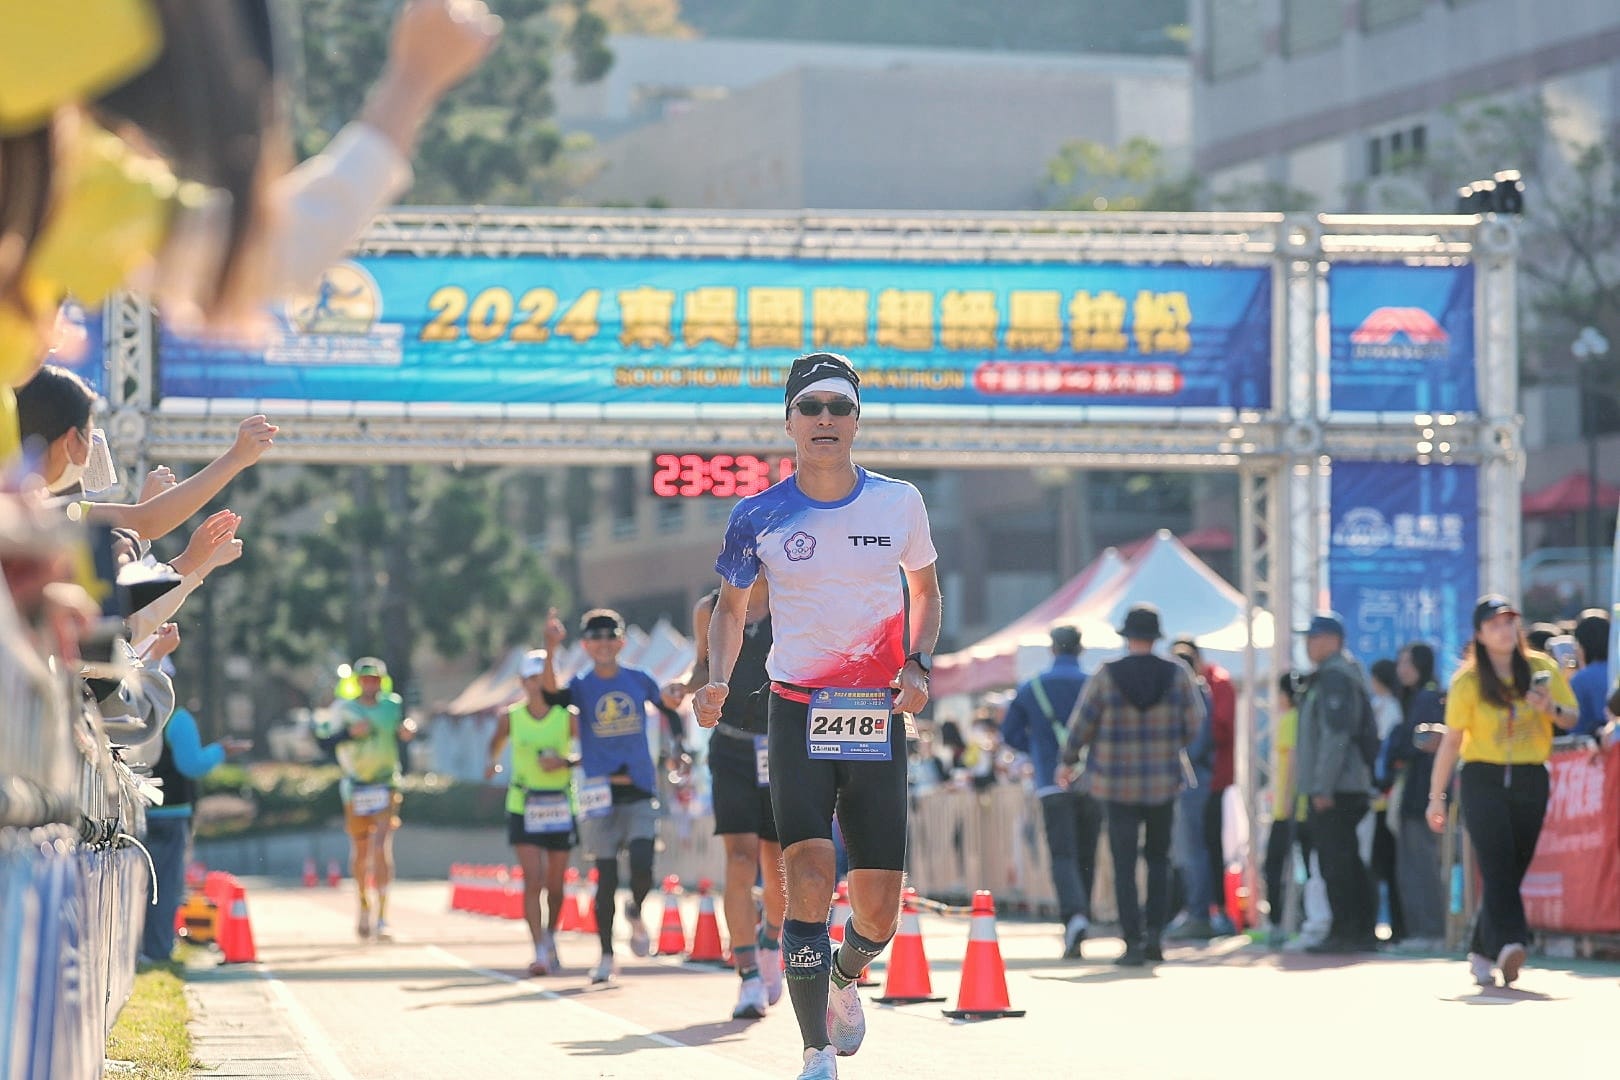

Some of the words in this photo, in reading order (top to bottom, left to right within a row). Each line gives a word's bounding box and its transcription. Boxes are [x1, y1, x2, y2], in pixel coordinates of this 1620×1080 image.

[419, 286, 601, 342] 2024
[614, 366, 741, 388] SOOCHOW
[848, 535, 892, 547] TPE
[812, 716, 874, 736] 2418
[788, 952, 822, 963] UTMB
